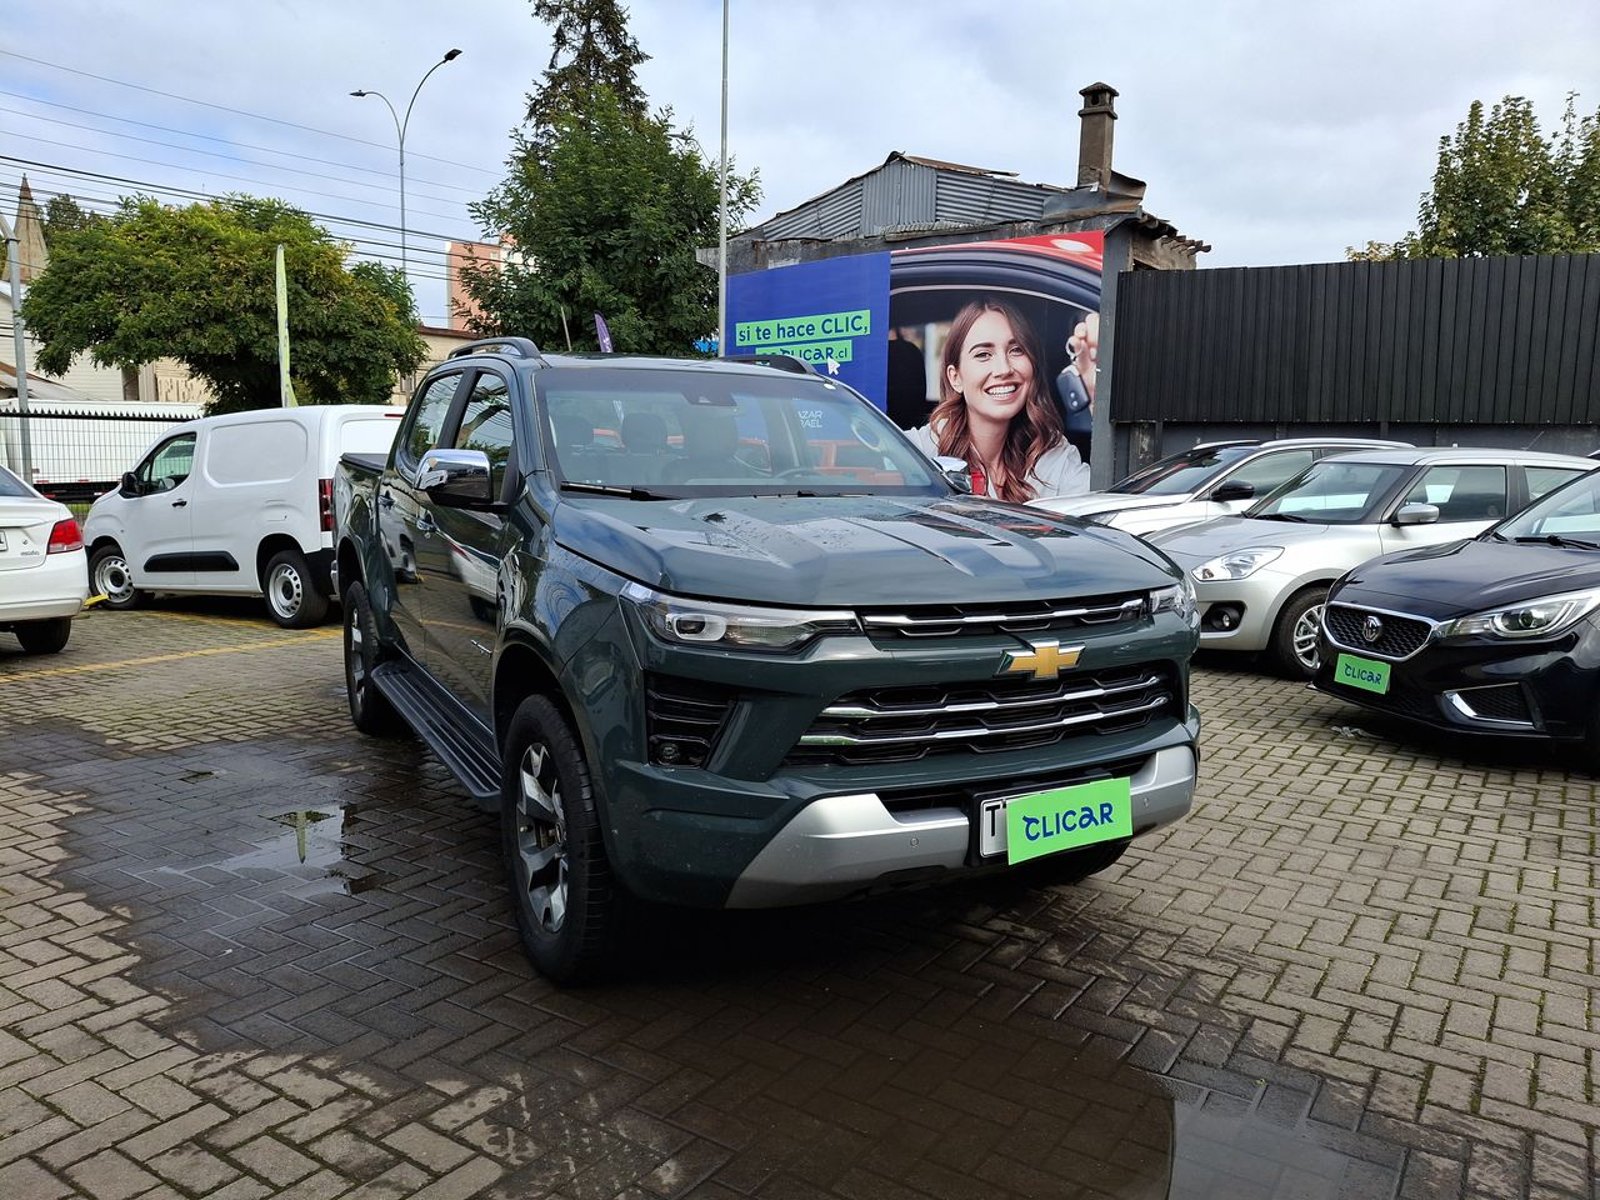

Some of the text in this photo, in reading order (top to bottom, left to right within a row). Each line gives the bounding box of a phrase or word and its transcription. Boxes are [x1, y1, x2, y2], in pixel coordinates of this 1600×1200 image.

[738, 315, 868, 342] si te hace CLIC,
